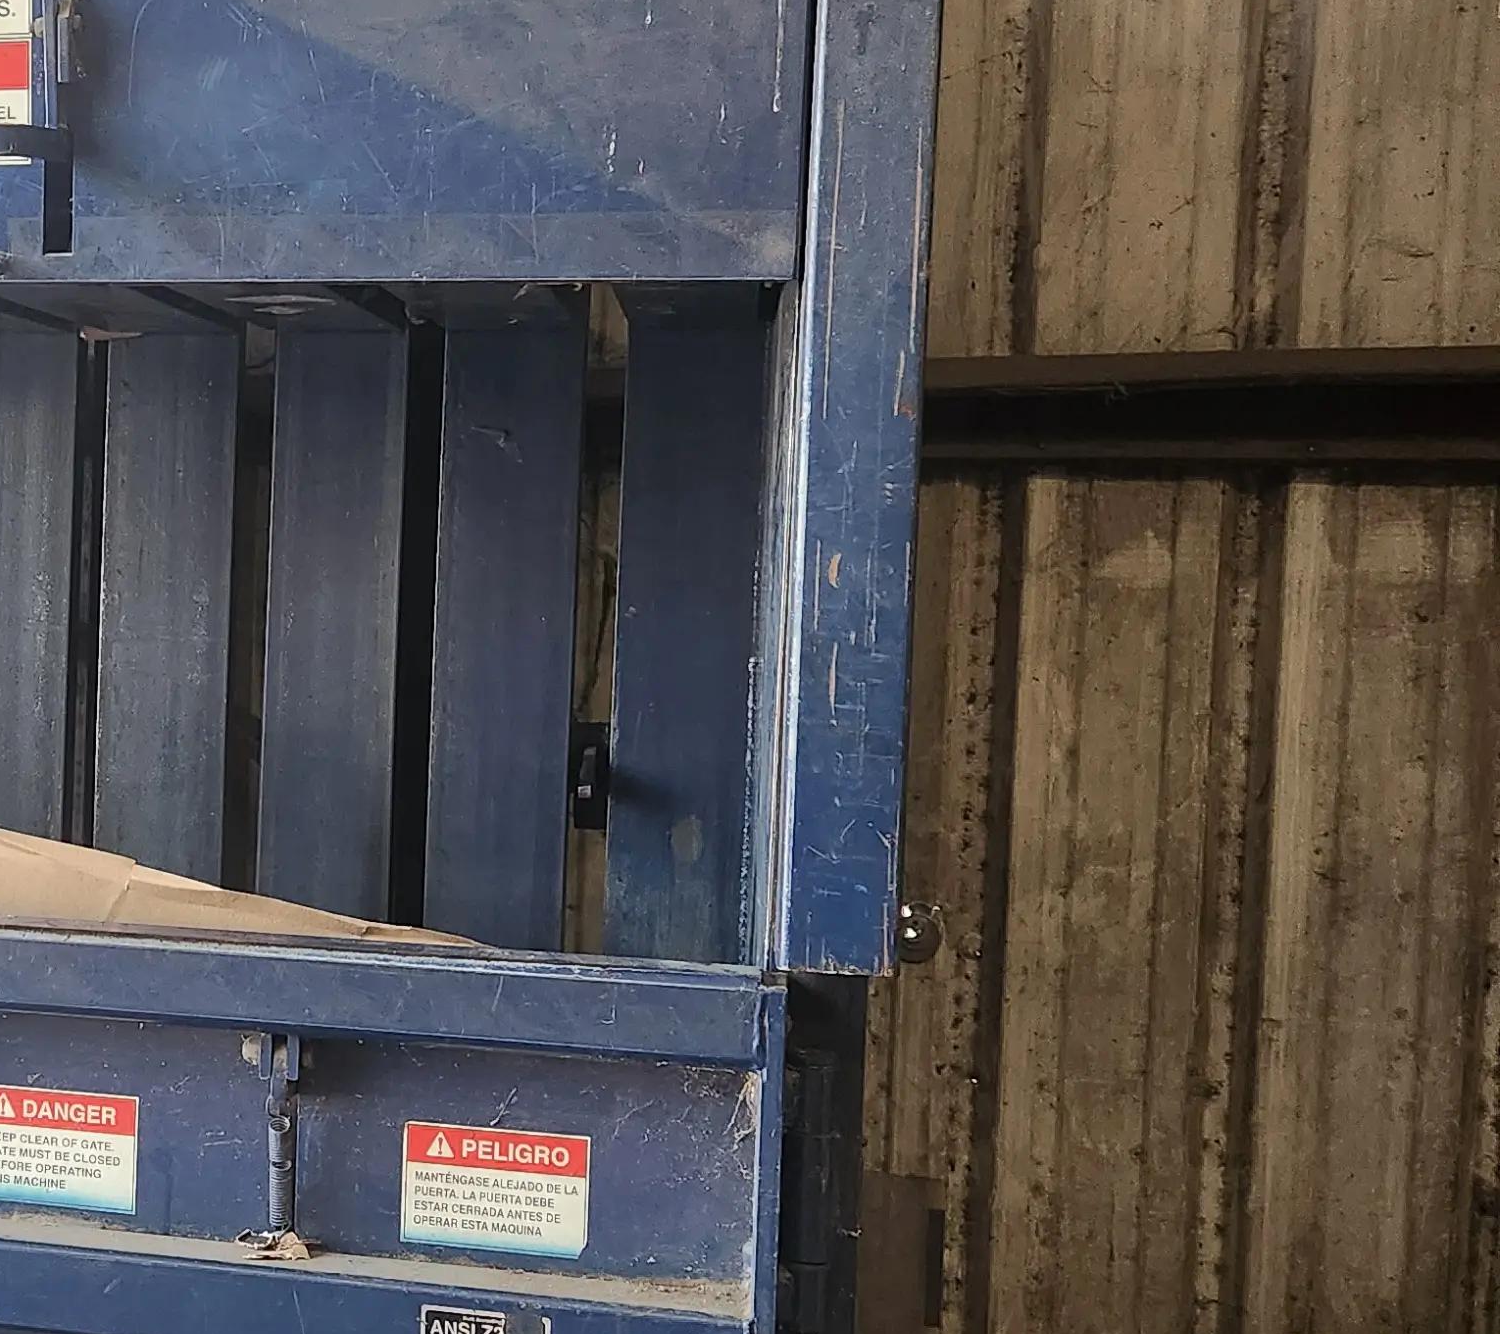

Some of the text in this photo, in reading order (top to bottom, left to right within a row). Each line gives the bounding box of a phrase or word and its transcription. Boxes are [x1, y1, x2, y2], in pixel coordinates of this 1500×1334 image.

[23, 1100, 116, 1125] DANGER
[19, 1133, 58, 1146] CLEAR
[61, 1137, 77, 1147] OF
[19, 1147, 51, 1159] MUST
[54, 1150, 69, 1161] BE
[73, 1152, 120, 1166] CLOSED
[462, 1139, 569, 1167] PELIGRO
[35, 1163, 101, 1178] OPERATING
[13, 1175, 65, 1189] MACHINE
[491, 1178, 543, 1192] ALEJADO
[546, 1183, 560, 1194] DE
[564, 1184, 578, 1195] LA
[414, 1185, 554, 1208] PUERTA. LA PUERTA DEBE
[414, 1199, 560, 1223] ESTAR CERRADA ANTES DE
[413, 1214, 457, 1227] OPERAR
[461, 1219, 488, 1231] ESTA
